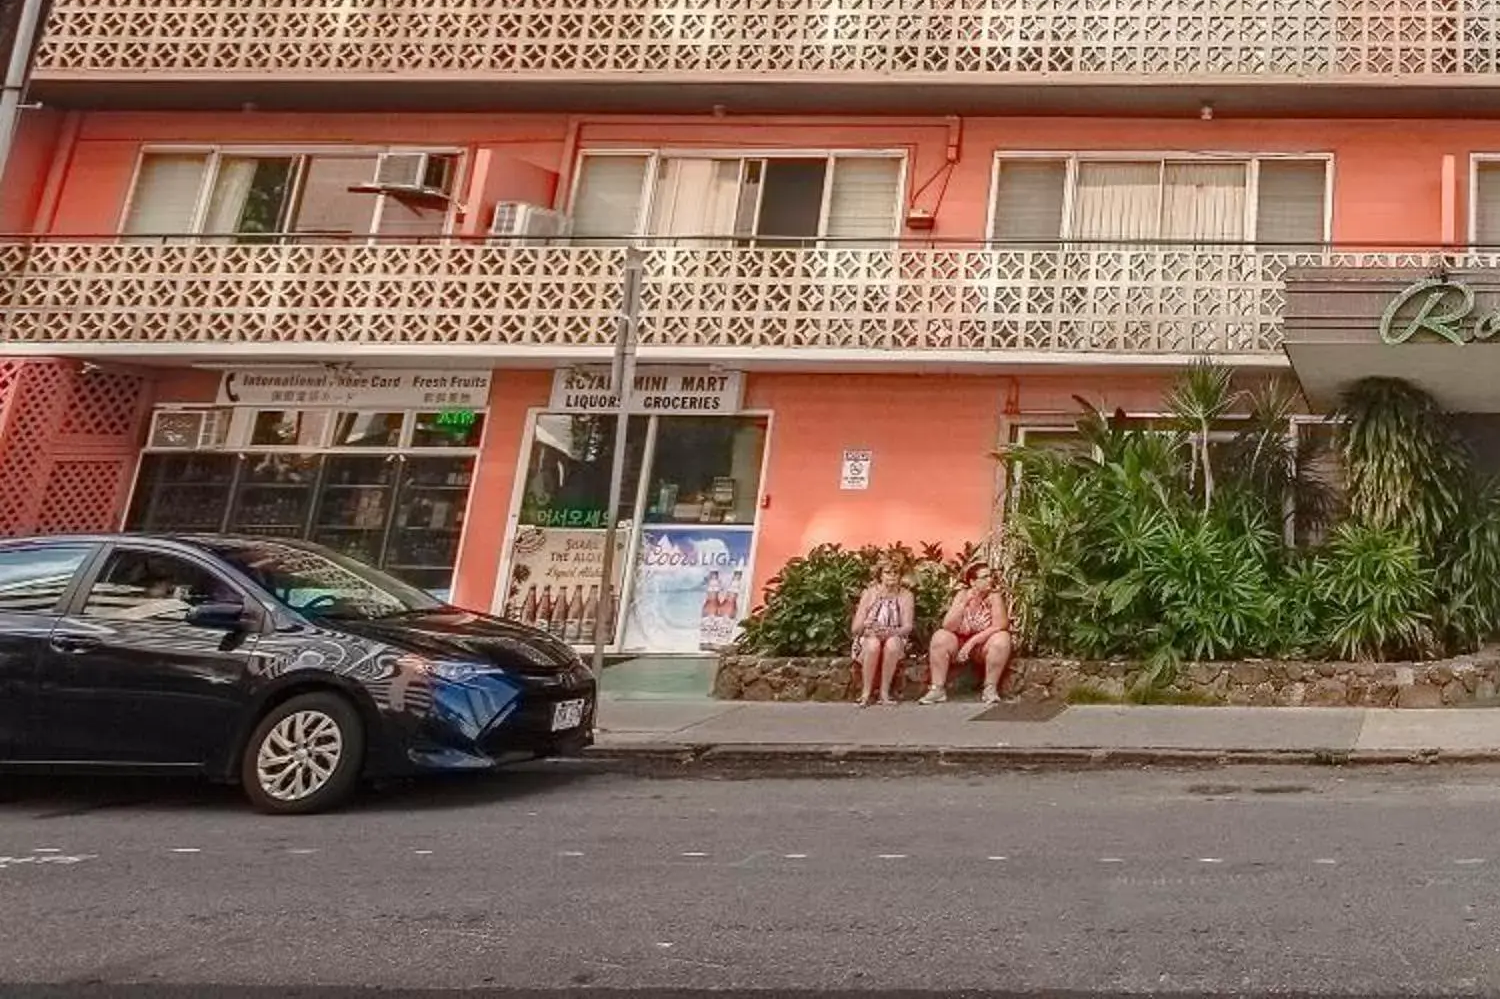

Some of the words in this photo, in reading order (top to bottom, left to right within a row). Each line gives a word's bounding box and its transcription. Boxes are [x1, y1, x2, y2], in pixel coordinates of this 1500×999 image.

[243, 373, 327, 387] International
[371, 375, 401, 388] Card
[412, 375, 447, 388] Fresh
[449, 376, 488, 388] Fruits
[634, 376, 668, 391] MINI
[681, 376, 728, 392] MART
[643, 396, 721, 410] GROCERIES
